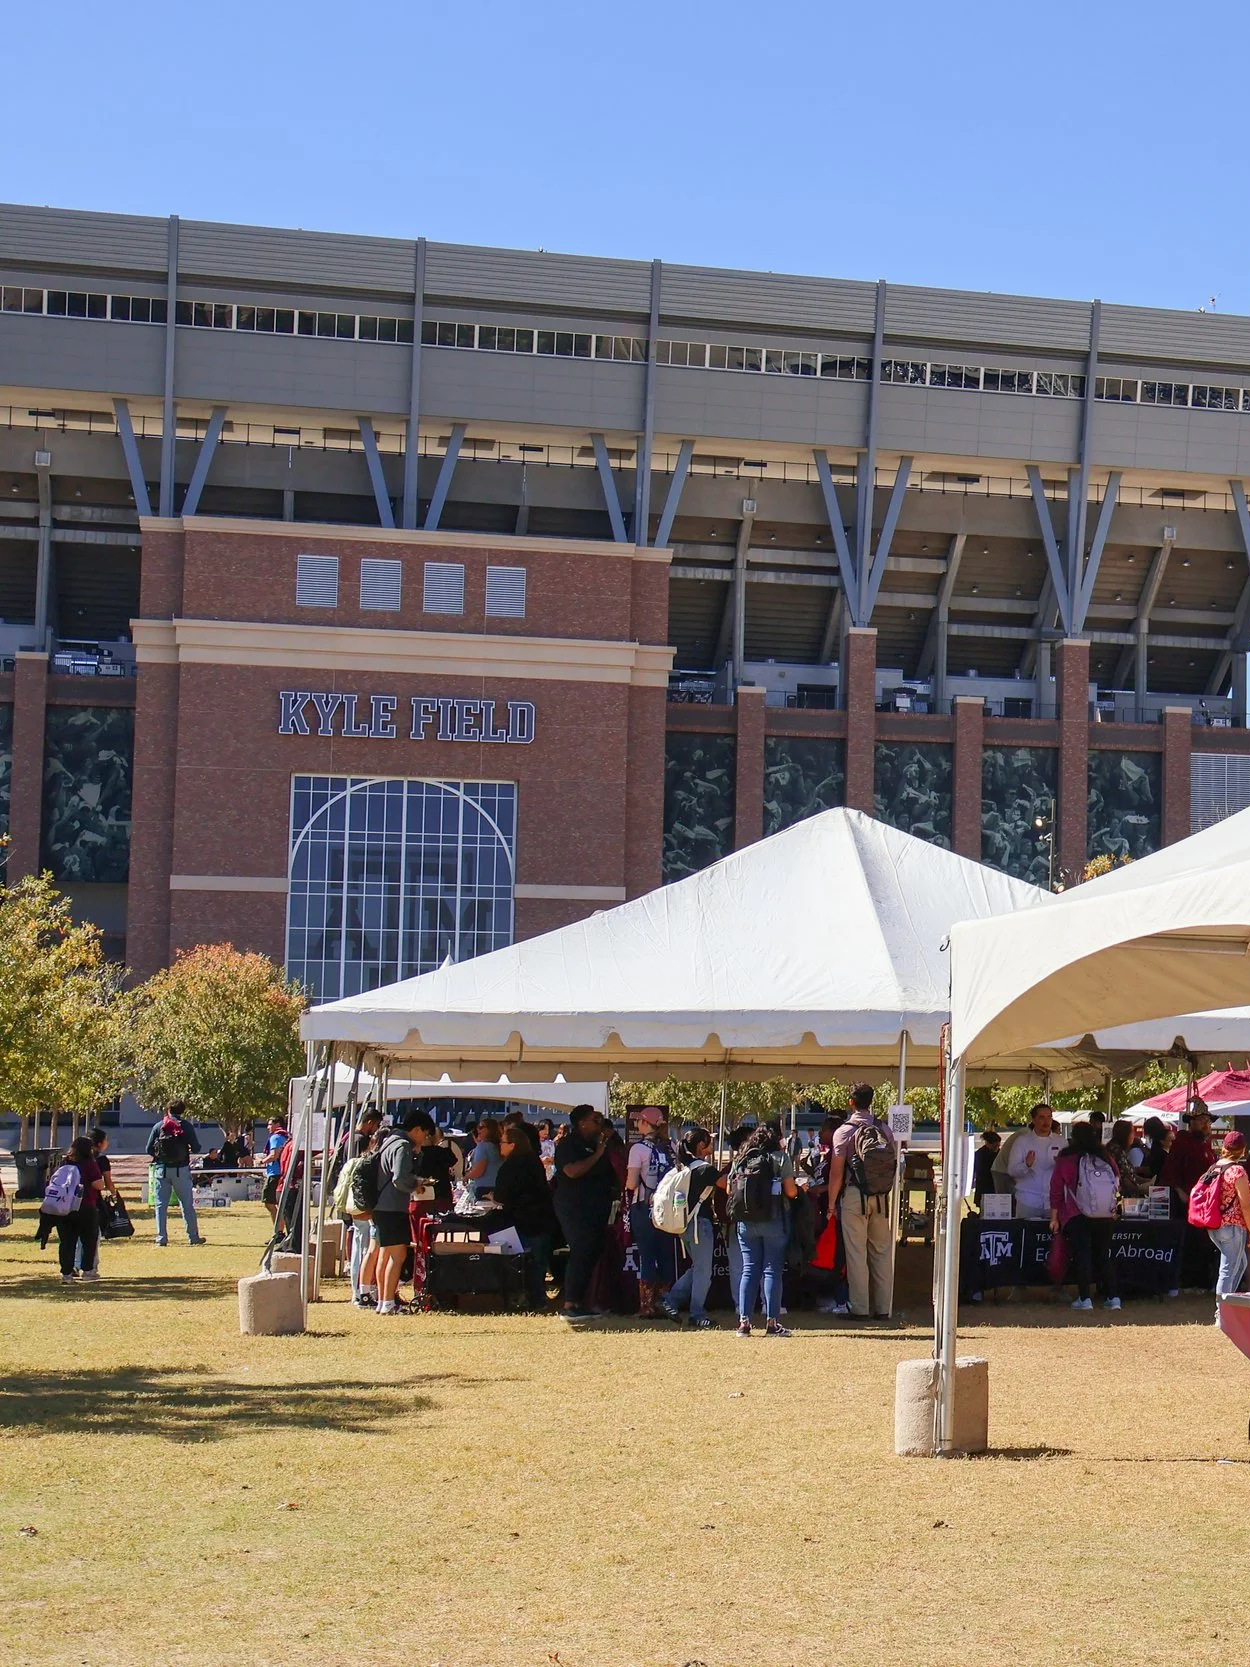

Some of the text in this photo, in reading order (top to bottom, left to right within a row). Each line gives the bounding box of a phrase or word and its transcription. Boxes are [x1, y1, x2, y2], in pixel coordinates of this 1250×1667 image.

[279, 691, 536, 745] KYLE FIELD
[979, 1230, 1013, 1266] ATM
[1115, 1244, 1174, 1263] Abroad
